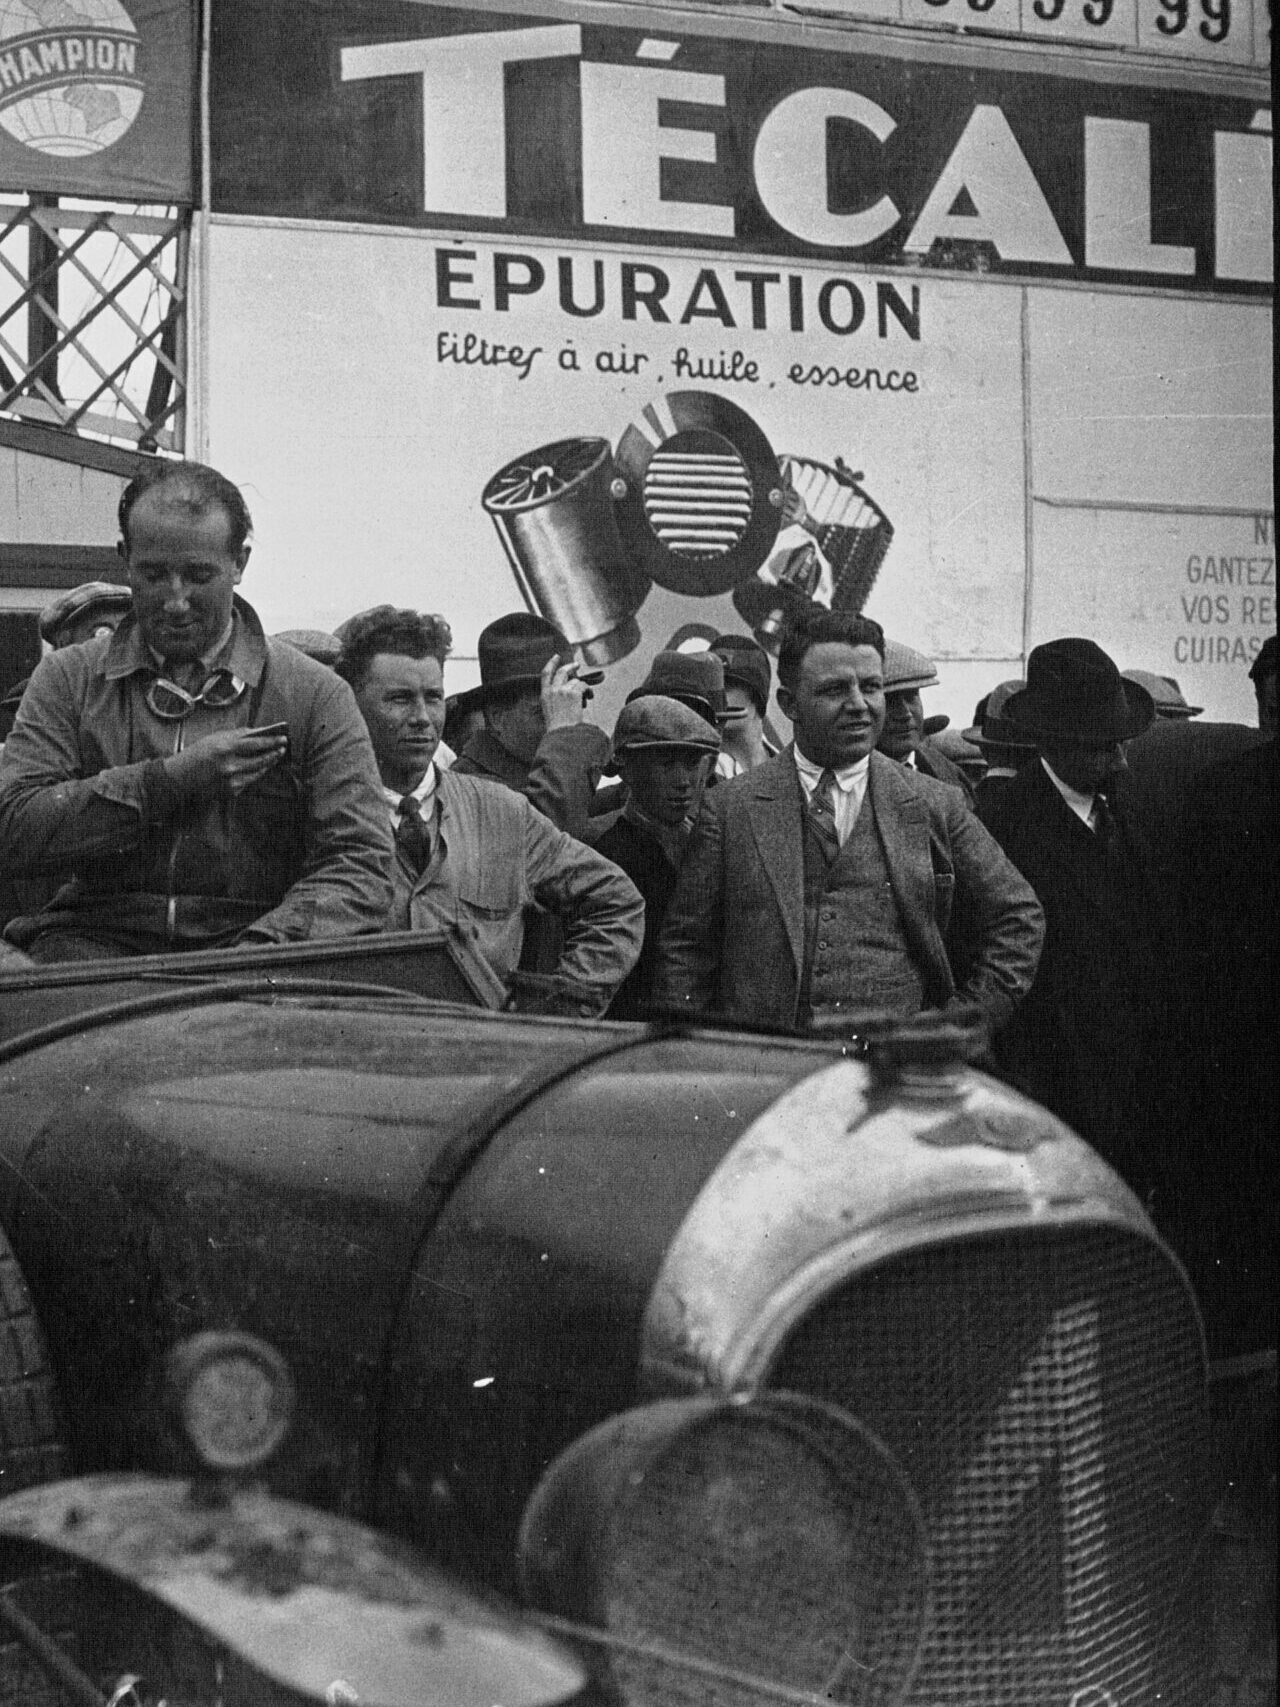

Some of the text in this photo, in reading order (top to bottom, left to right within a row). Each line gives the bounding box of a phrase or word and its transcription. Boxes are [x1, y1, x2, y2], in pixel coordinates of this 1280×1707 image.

[435, 239, 921, 341] ÉPURATION
[558, 339, 579, 372] à
[787, 360, 920, 392] essence
[1186, 555, 1275, 586] GANTEZ
[1181, 594, 1230, 624] VOS
[1174, 635, 1263, 664] CUIRAS
